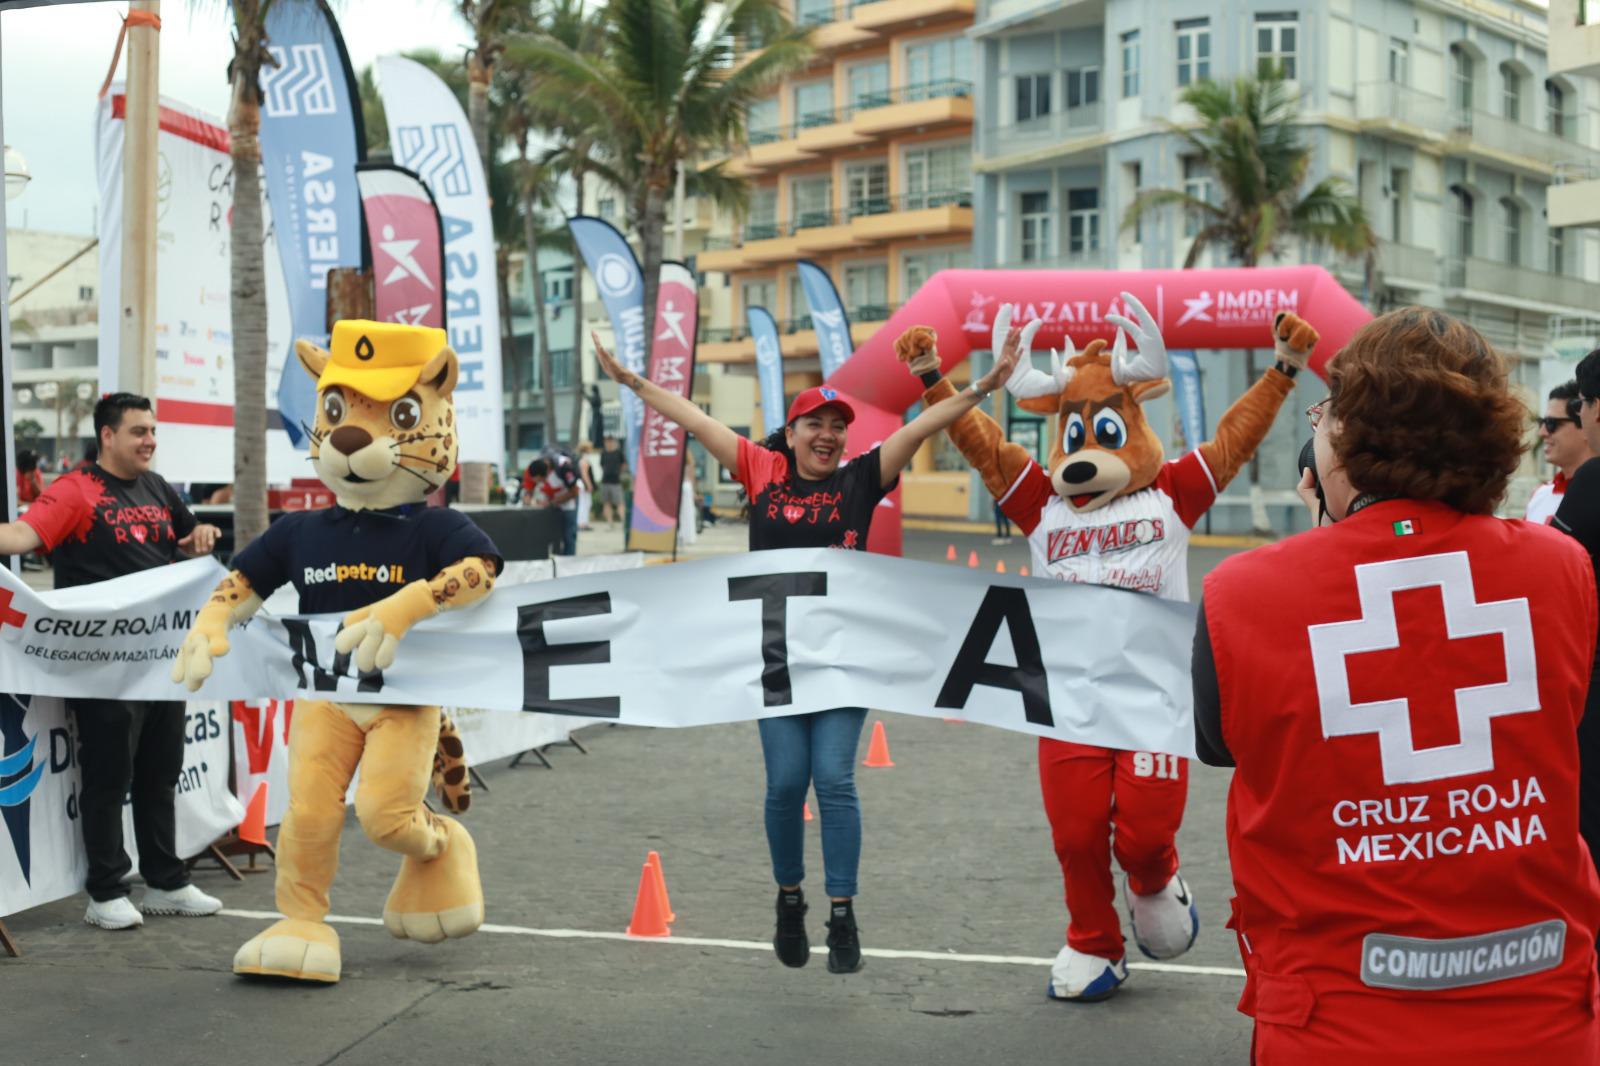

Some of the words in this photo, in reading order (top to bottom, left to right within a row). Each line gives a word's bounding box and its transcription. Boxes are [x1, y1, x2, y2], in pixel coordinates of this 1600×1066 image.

[1217, 288, 1299, 310] IMDEM
[34, 616, 108, 638] CRUZ
[110, 612, 168, 637] ROJA
[24, 644, 110, 662] DELEGACIÓN
[112, 645, 180, 662] MAZATLÁN
[281, 571, 1055, 728] META
[1133, 752, 1179, 780] 911
[1332, 795, 1430, 827] CRUZ
[1448, 776, 1546, 818] ROJA
[1336, 814, 1547, 864] MEXICANA
[1368, 928, 1561, 978] COMUNICACIÓN
